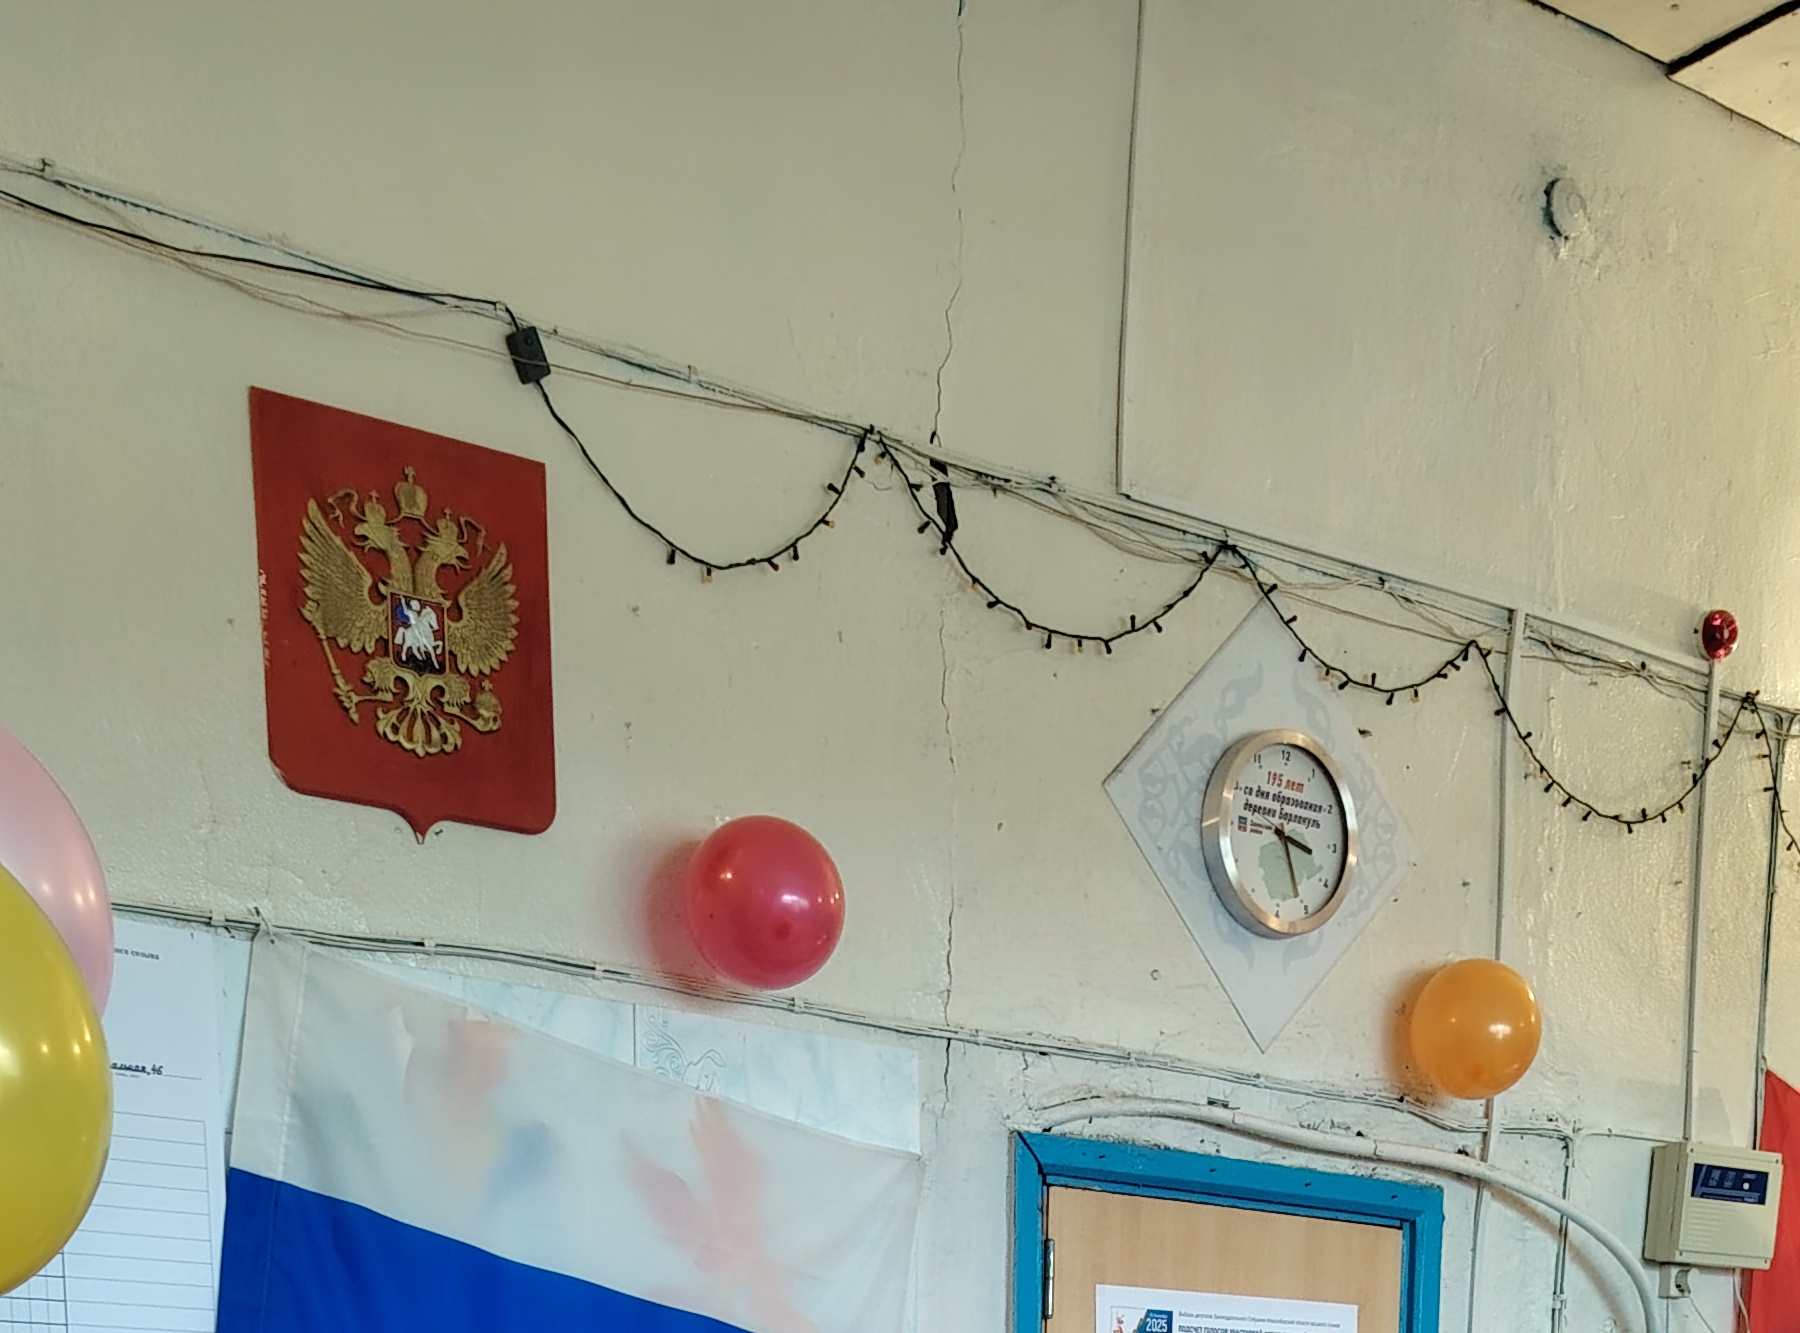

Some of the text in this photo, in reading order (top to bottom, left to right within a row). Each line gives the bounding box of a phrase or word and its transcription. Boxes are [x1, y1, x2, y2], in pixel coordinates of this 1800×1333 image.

[1266, 770, 1304, 794] 195 лет
[1243, 785, 1254, 797] со
[1255, 784, 1270, 800] дня
[1272, 790, 1323, 814] образования
[1243, 798, 1277, 818] деревни
[1145, 1318, 1168, 1333] 2025
